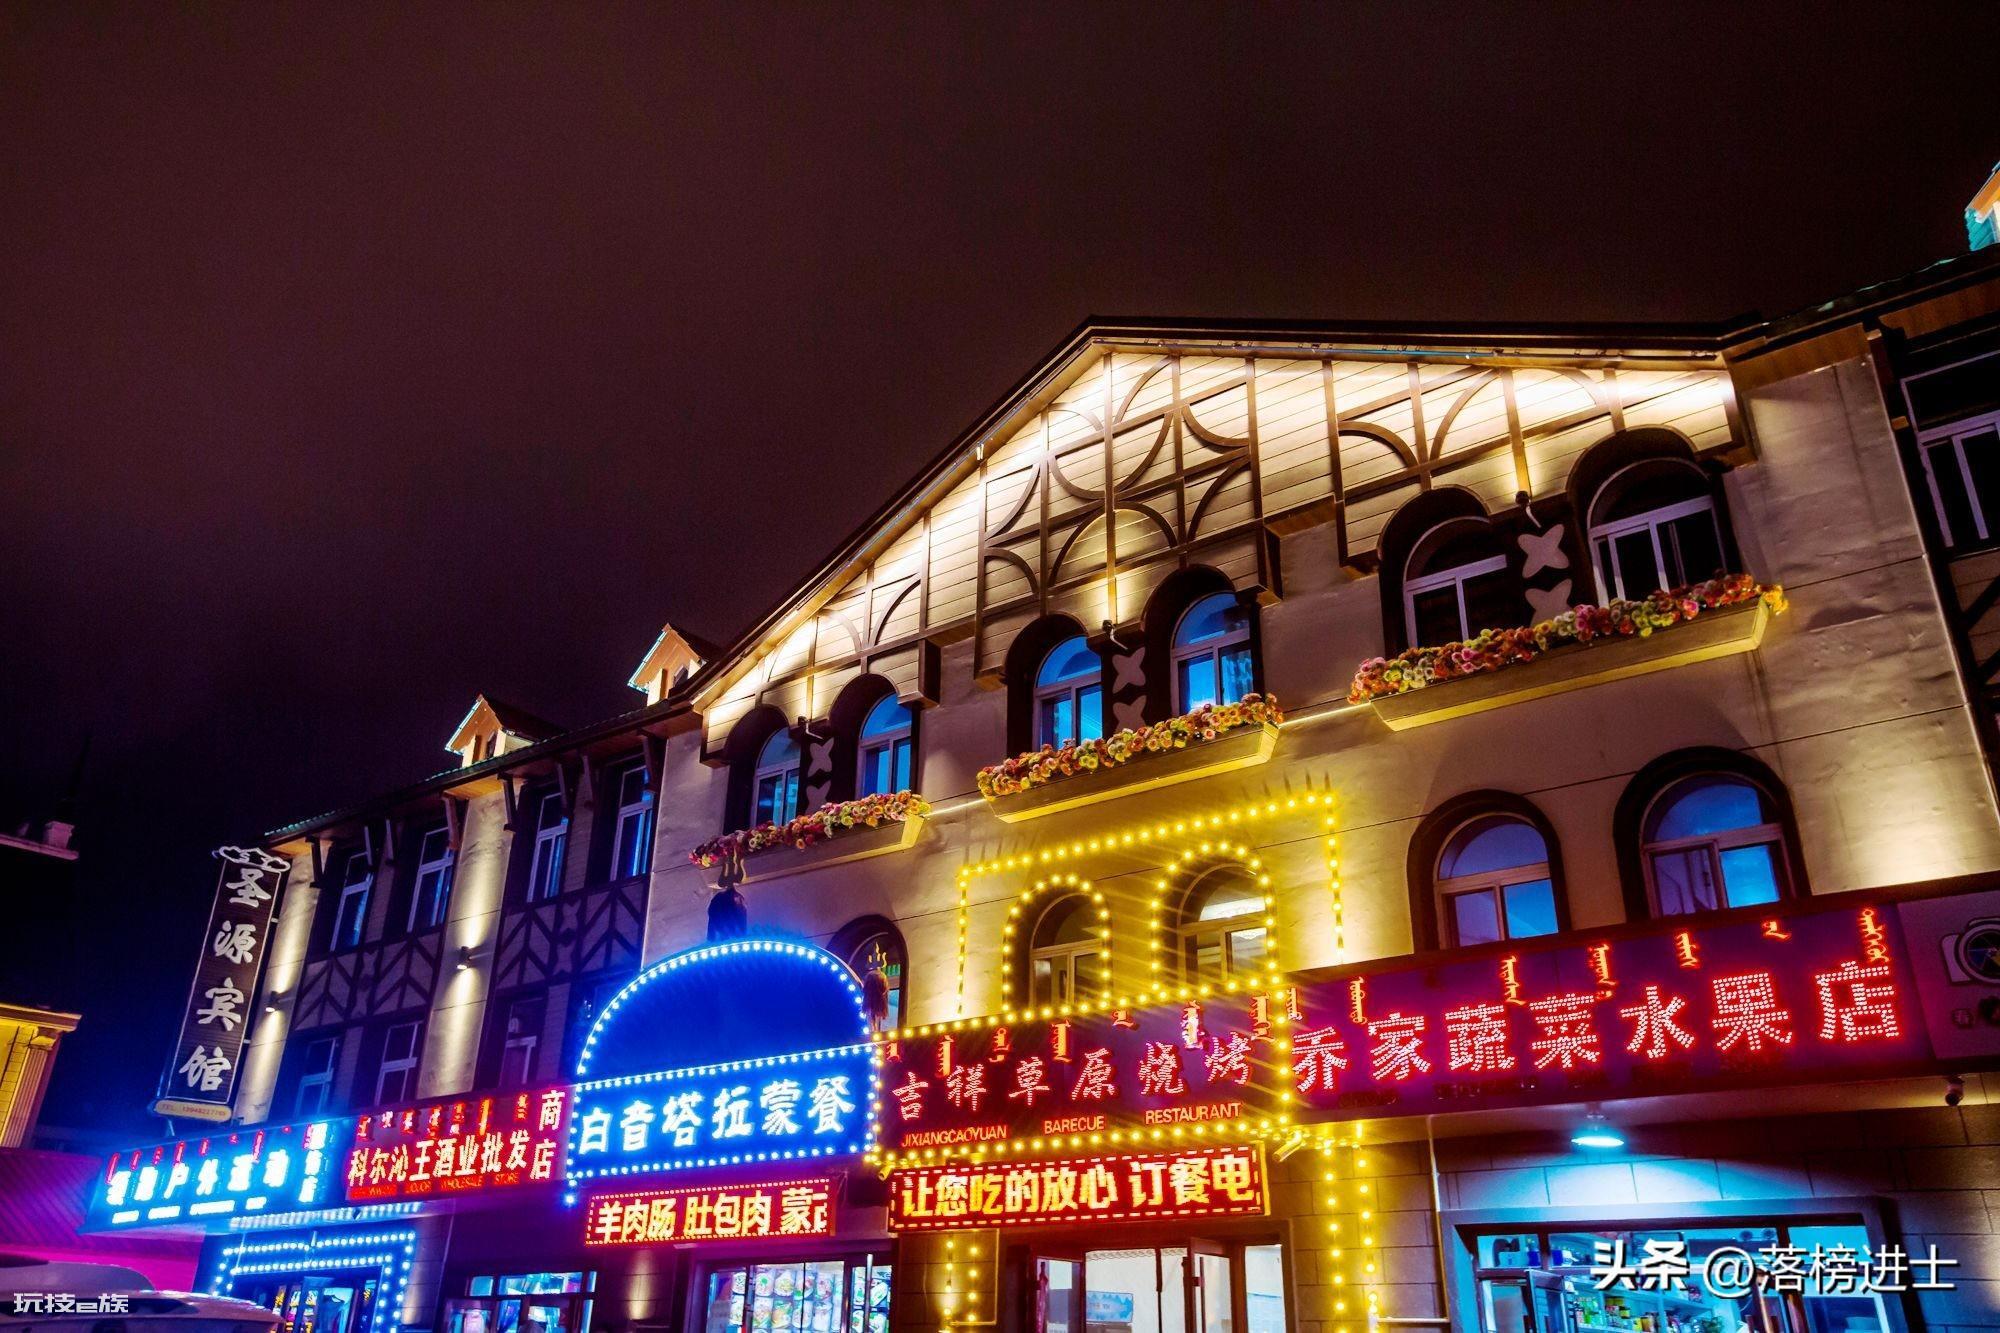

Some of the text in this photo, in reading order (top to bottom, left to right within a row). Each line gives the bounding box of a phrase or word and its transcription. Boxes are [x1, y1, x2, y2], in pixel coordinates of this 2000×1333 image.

[179, 868, 272, 1092] 圣源宾馆
[1292, 961, 1900, 1092] 乔家蔬菜水果店
[578, 1076, 855, 1155] 白音塔拉蒙餐
[892, 1031, 1253, 1121] 吉祥草原烧烤
[347, 1129, 531, 1187] 科尔沁王酒业批发
[530, 1090, 565, 1180] 商店
[901, 1102, 1242, 1147] JIXIANGCAOYUAN BARECUE RESTAURANT
[595, 1198, 676, 1243] 羊肉肠
[684, 1191, 772, 1236] 肚包肉
[902, 1154, 1255, 1218] 让您吃的放心 订餐电
